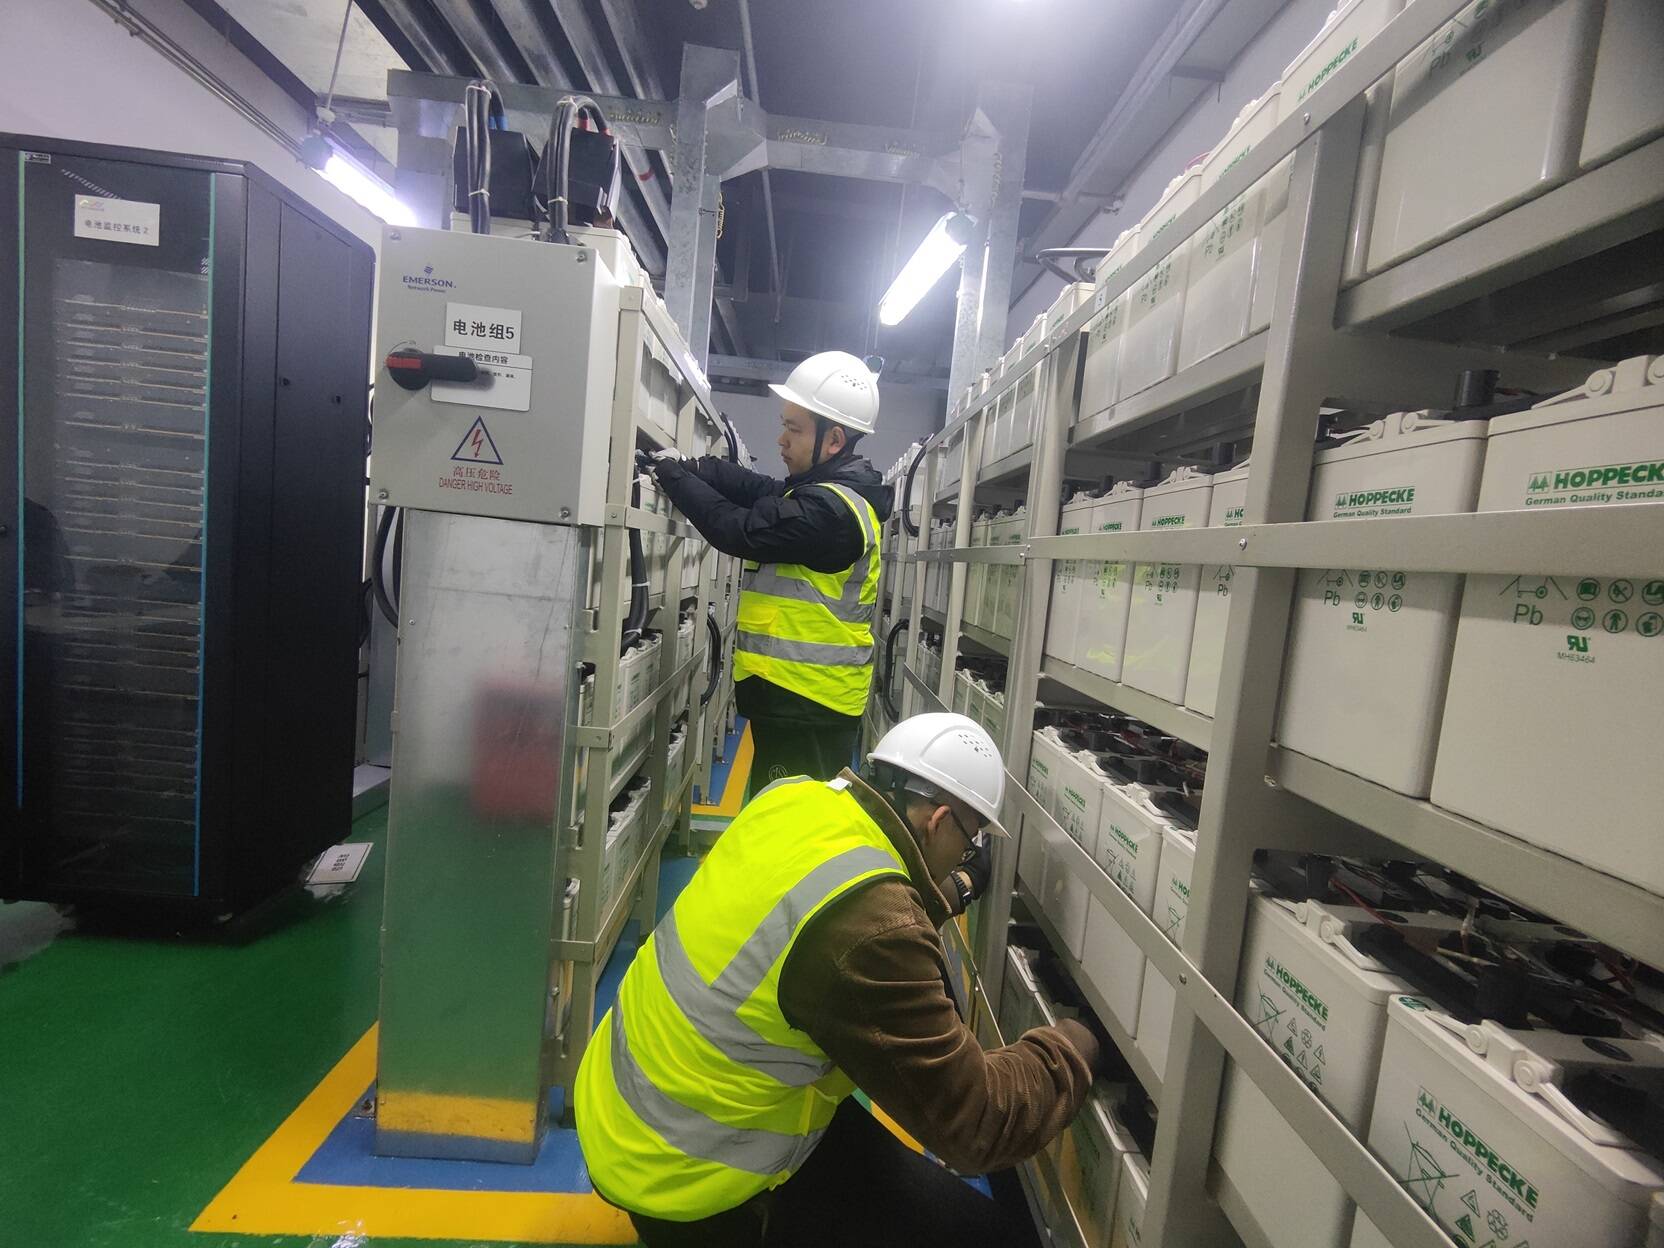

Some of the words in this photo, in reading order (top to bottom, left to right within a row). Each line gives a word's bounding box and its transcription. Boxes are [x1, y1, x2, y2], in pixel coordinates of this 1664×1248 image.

[453, 319, 515, 340] 电池组5
[453, 466, 501, 481] 高压危险
[1553, 463, 1664, 490] HOPPECK
[439, 477, 466, 490] DANGER
[467, 480, 484, 492] HIGH
[484, 482, 513, 495] VOLTAGE
[1348, 488, 1415, 506] HOPPECKE
[1525, 496, 1566, 505] German
[1570, 492, 1612, 503] Quality
[1616, 489, 1664, 500] Standa
[1380, 507, 1412, 515] Standard
[1217, 583, 1228, 597] Pb
[1323, 590, 1341, 607] Pb
[1513, 603, 1543, 626] Pb
[1276, 965, 1329, 1021] HOPPECKE
[1416, 1108, 1448, 1142] German
[1450, 1141, 1483, 1176] Quality
[1486, 1173, 1534, 1223] Standard
[1439, 1106, 1539, 1209] HOPPECKE
